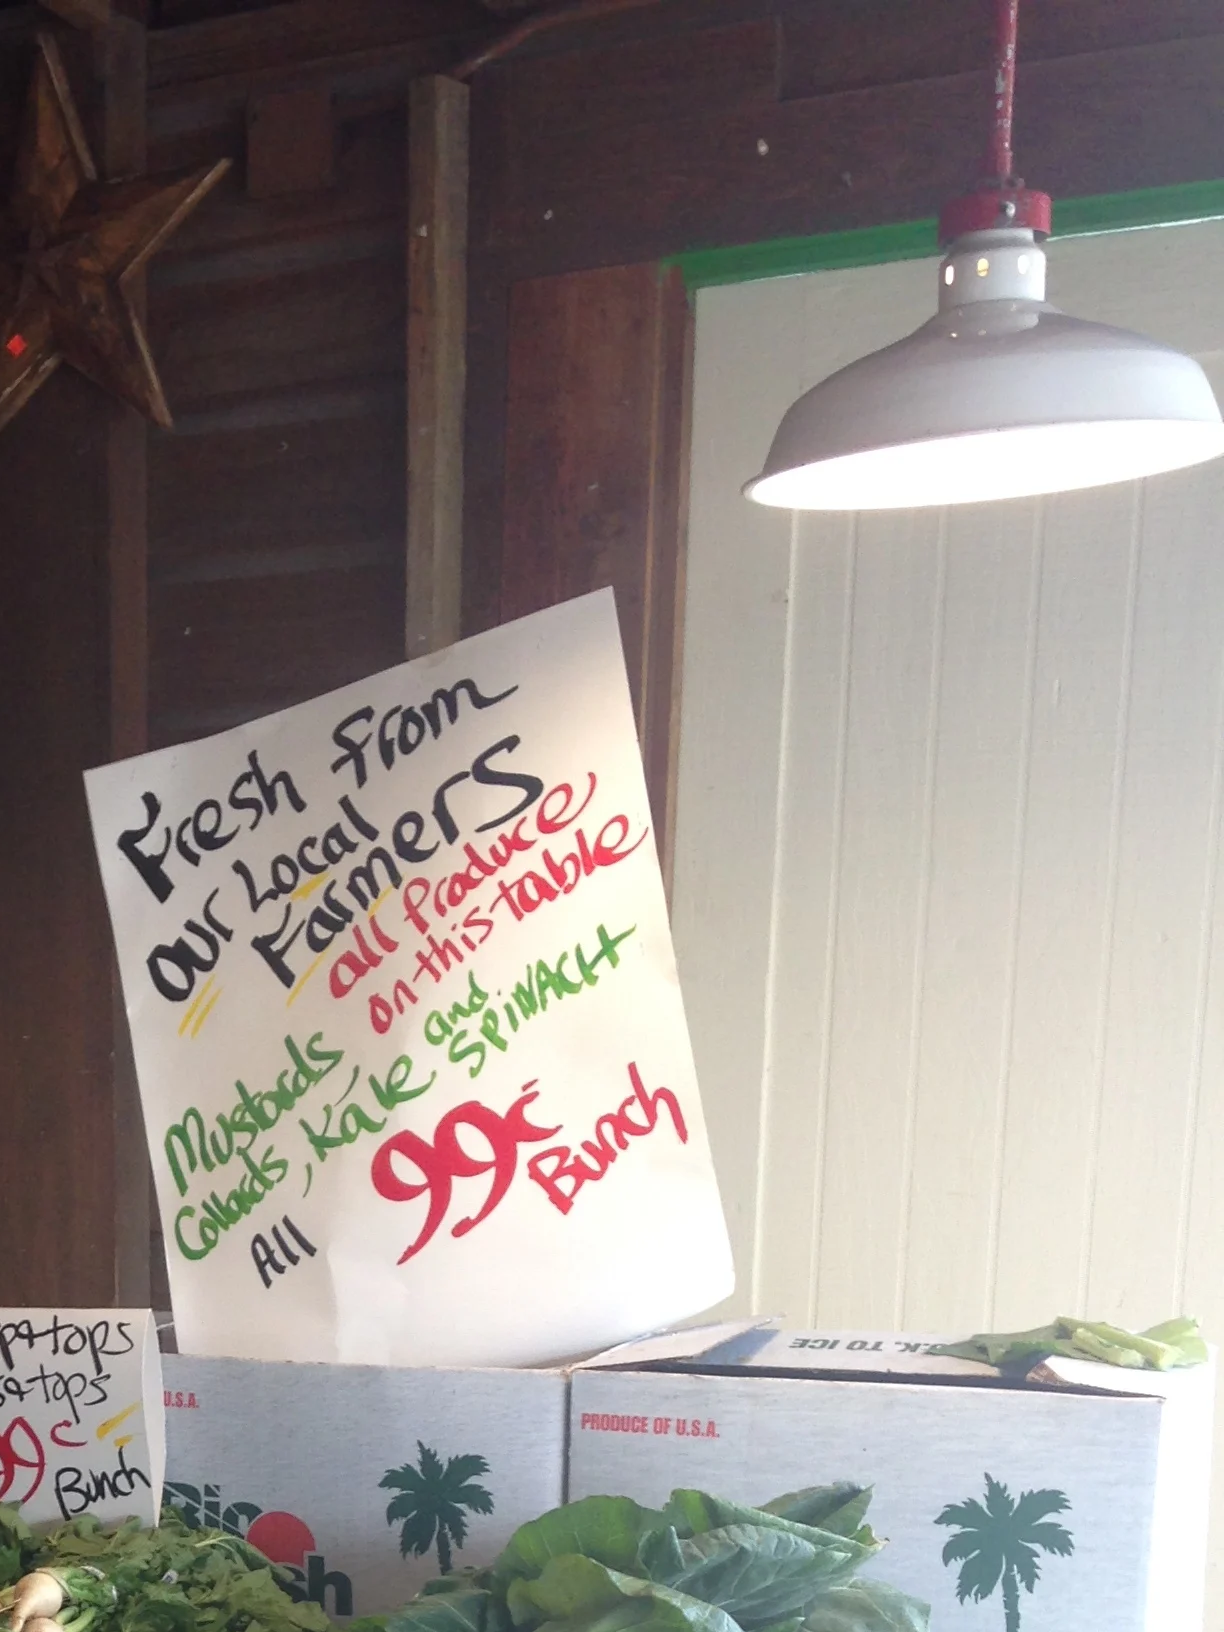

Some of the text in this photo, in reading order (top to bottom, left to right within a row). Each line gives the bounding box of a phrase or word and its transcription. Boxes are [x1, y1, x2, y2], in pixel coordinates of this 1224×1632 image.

[117, 750, 307, 904] Fresh
[368, 814, 649, 1035] on this table
[250, 1213, 318, 1289] All
[527, 1061, 689, 1216] Bunch
[789, 1338, 841, 1350] ICE
[846, 1340, 884, 1352] TO
[580, 1412, 721, 1438] PRODUCE OF U.S.A.
[53, 1445, 152, 1522] Bunch
